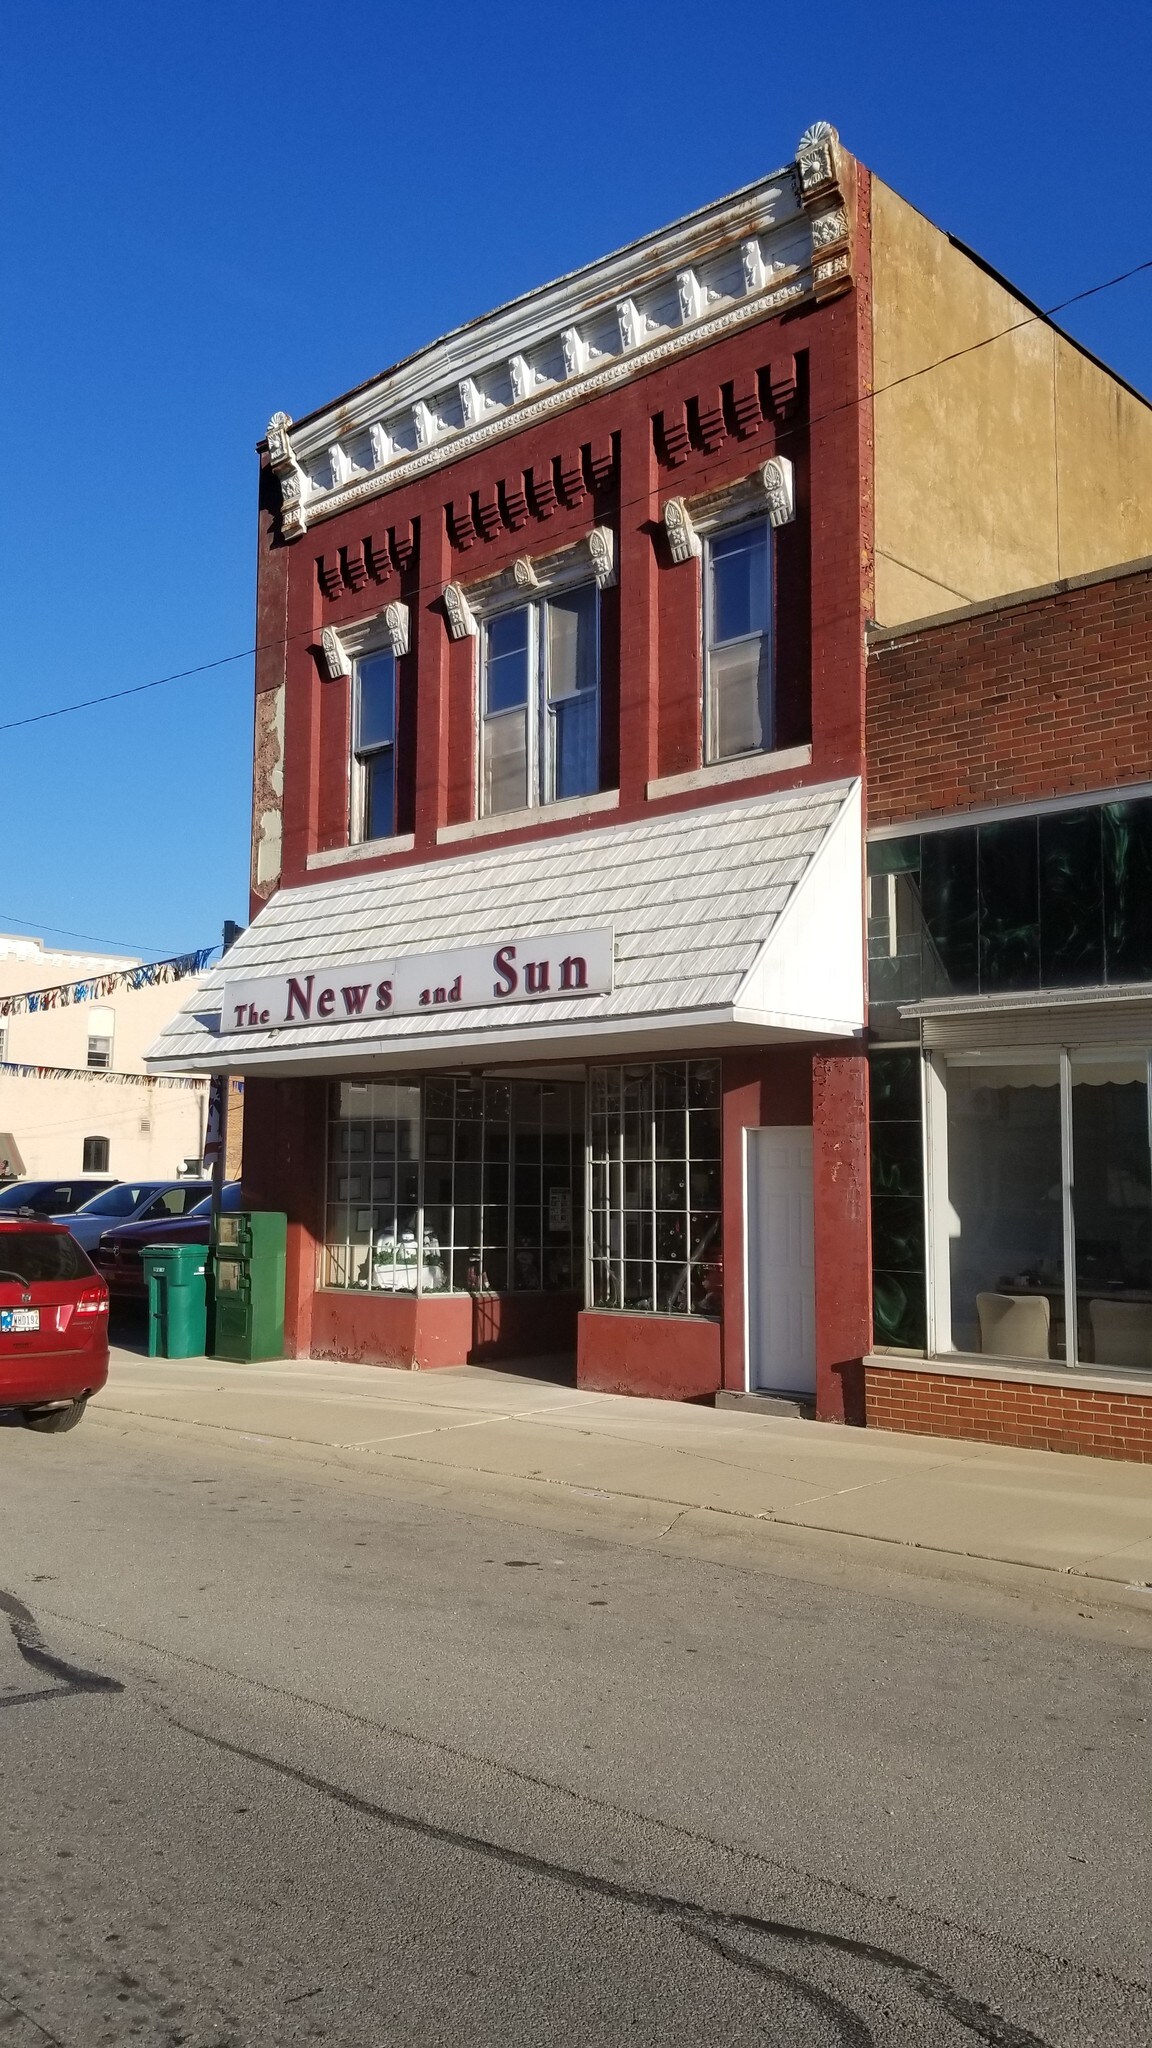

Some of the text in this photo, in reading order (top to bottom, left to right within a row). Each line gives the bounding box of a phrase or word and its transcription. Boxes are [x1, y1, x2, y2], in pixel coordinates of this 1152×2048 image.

[233, 945, 589, 1027] The News and Sun
